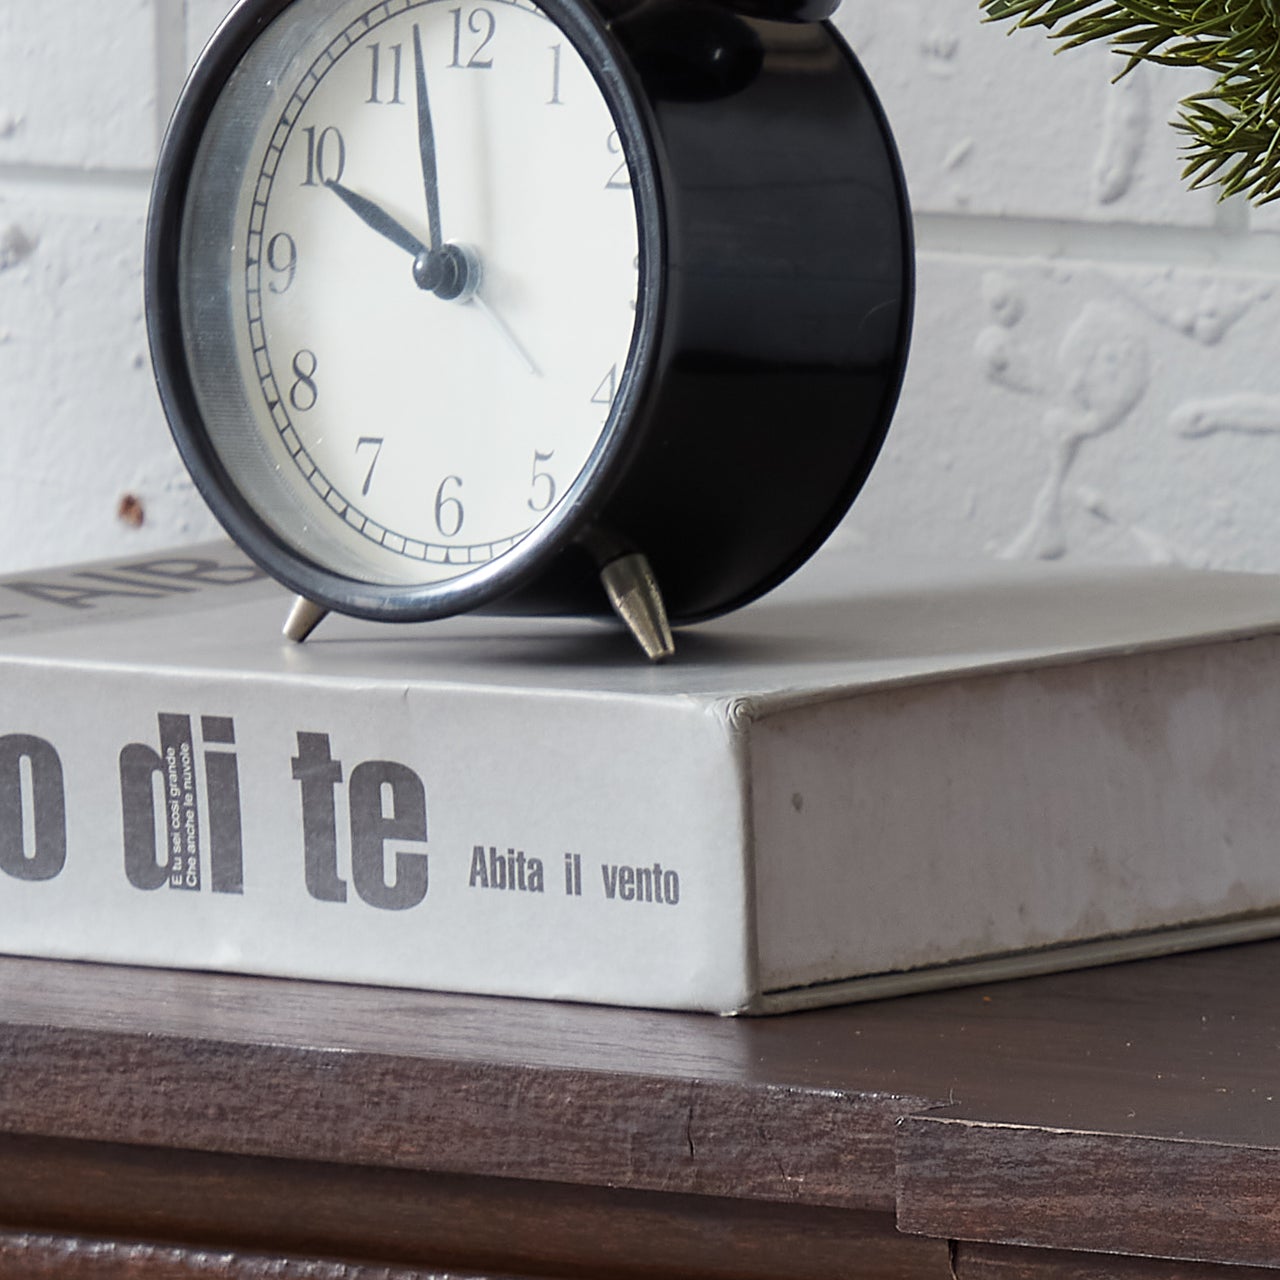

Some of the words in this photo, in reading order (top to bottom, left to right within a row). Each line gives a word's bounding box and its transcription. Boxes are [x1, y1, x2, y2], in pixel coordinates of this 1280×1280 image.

[446, 8, 496, 69] 12
[364, 42, 406, 105] 11
[545, 43, 566, 106] 1
[299, 125, 346, 188] 10
[604, 127, 633, 190] 2
[267, 232, 298, 295] 9
[290, 349, 318, 412] 8
[355, 437, 385, 497] 7
[527, 449, 557, 512] 5
[434, 475, 465, 537] 6
[165, 746, 181, 798] grande
[179, 741, 192, 790] nuvole
[119, 712, 244, 894] di
[291, 731, 429, 911] te
[183, 791, 194, 807] le
[171, 831, 182, 854] sei
[184, 808, 196, 854] anche
[171, 874, 183, 887] E
[172, 856, 183, 871] tu
[185, 856, 197, 887] Che
[468, 845, 545, 893] Abita
[564, 852, 582, 896] il
[601, 862, 681, 906] vento
